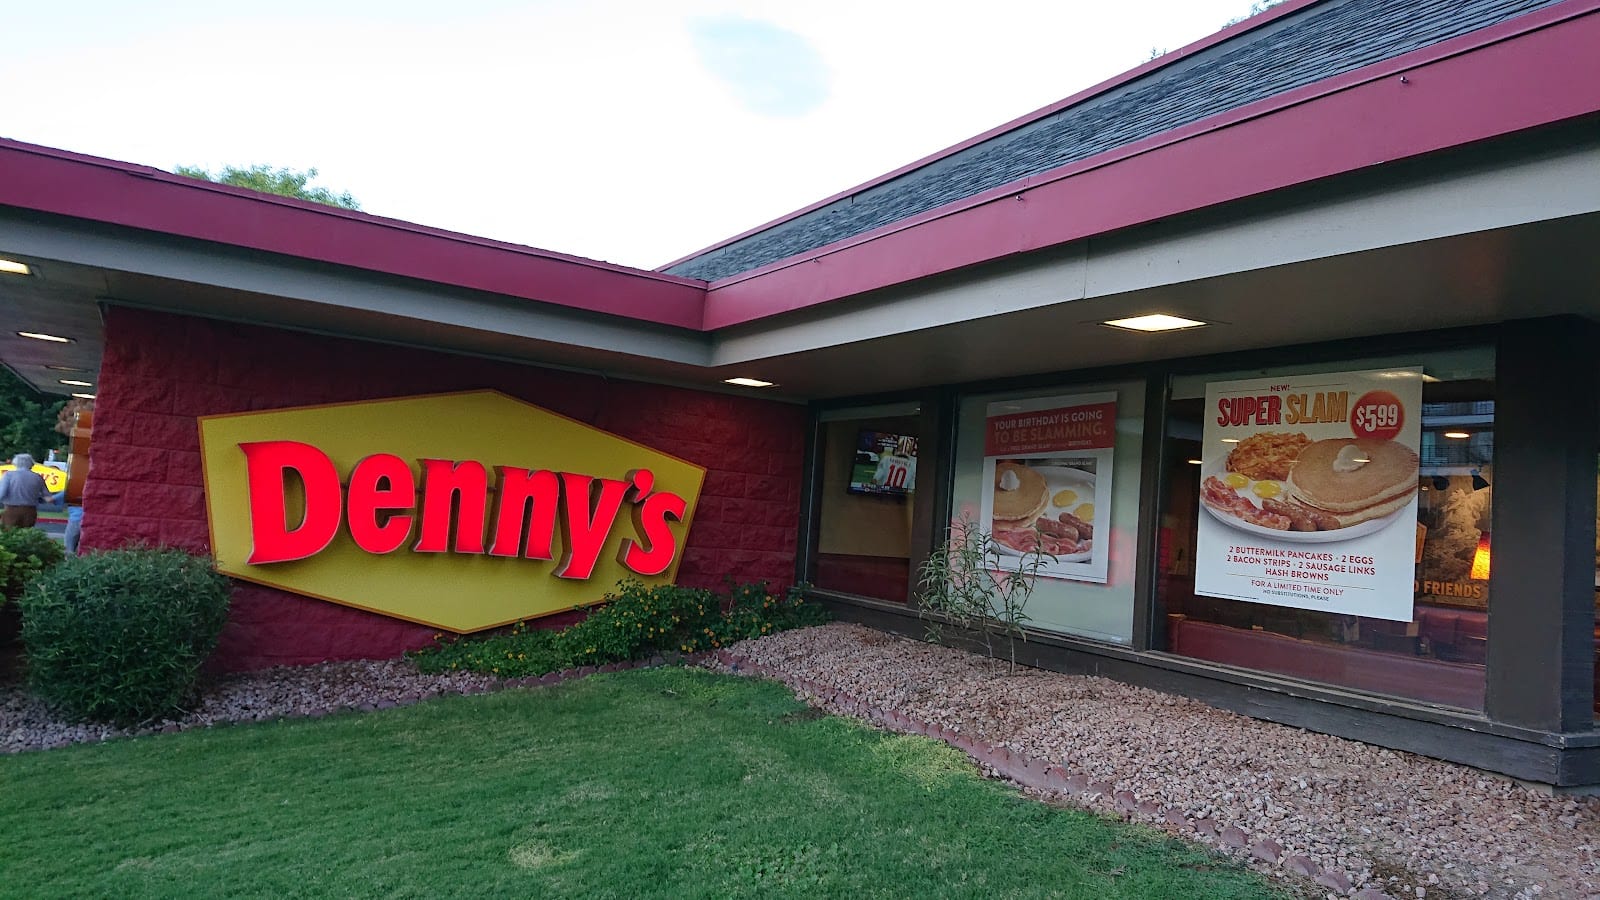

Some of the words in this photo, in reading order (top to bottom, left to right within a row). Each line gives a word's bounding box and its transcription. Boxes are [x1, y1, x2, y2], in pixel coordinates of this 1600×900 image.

[1270, 384, 1290, 392] NEW!
[1217, 395, 1282, 427] SUPER
[1286, 391, 1348, 424] SLAM
[995, 420, 1016, 430] YOUR
[1018, 415, 1059, 427] BIRTHDAY
[1061, 414, 1069, 423] IS
[1071, 410, 1103, 422] GOING
[994, 430, 1010, 443] TO
[1013, 428, 1028, 442] BE
[1030, 422, 1107, 441] SLAMMING.
[884, 464, 907, 488] 10
[237, 440, 687, 580] Denny's
[1227, 554, 1231, 562] 2
[1233, 555, 1261, 565] BACON
[1263, 558, 1291, 568] STRIPS
[1298, 561, 1304, 569] 2
[1305, 562, 1346, 573] SAUSAGE
[1348, 565, 1376, 576] LINKS
[1235, 546, 1286, 558] BUTTERMILK
[1287, 550, 1333, 562] PANCAKES
[1341, 554, 1347, 563] 2
[1349, 556, 1374, 565] EGGS
[1265, 568, 1289, 577] HASH
[1290, 570, 1329, 581] BROWNS
[1251, 579, 1266, 588] FOR
[1273, 582, 1302, 592] LIMITED
[1303, 585, 1322, 595] TIME
[1323, 587, 1344, 596] ONLY
[1423, 580, 1481, 599] FRIENDS
